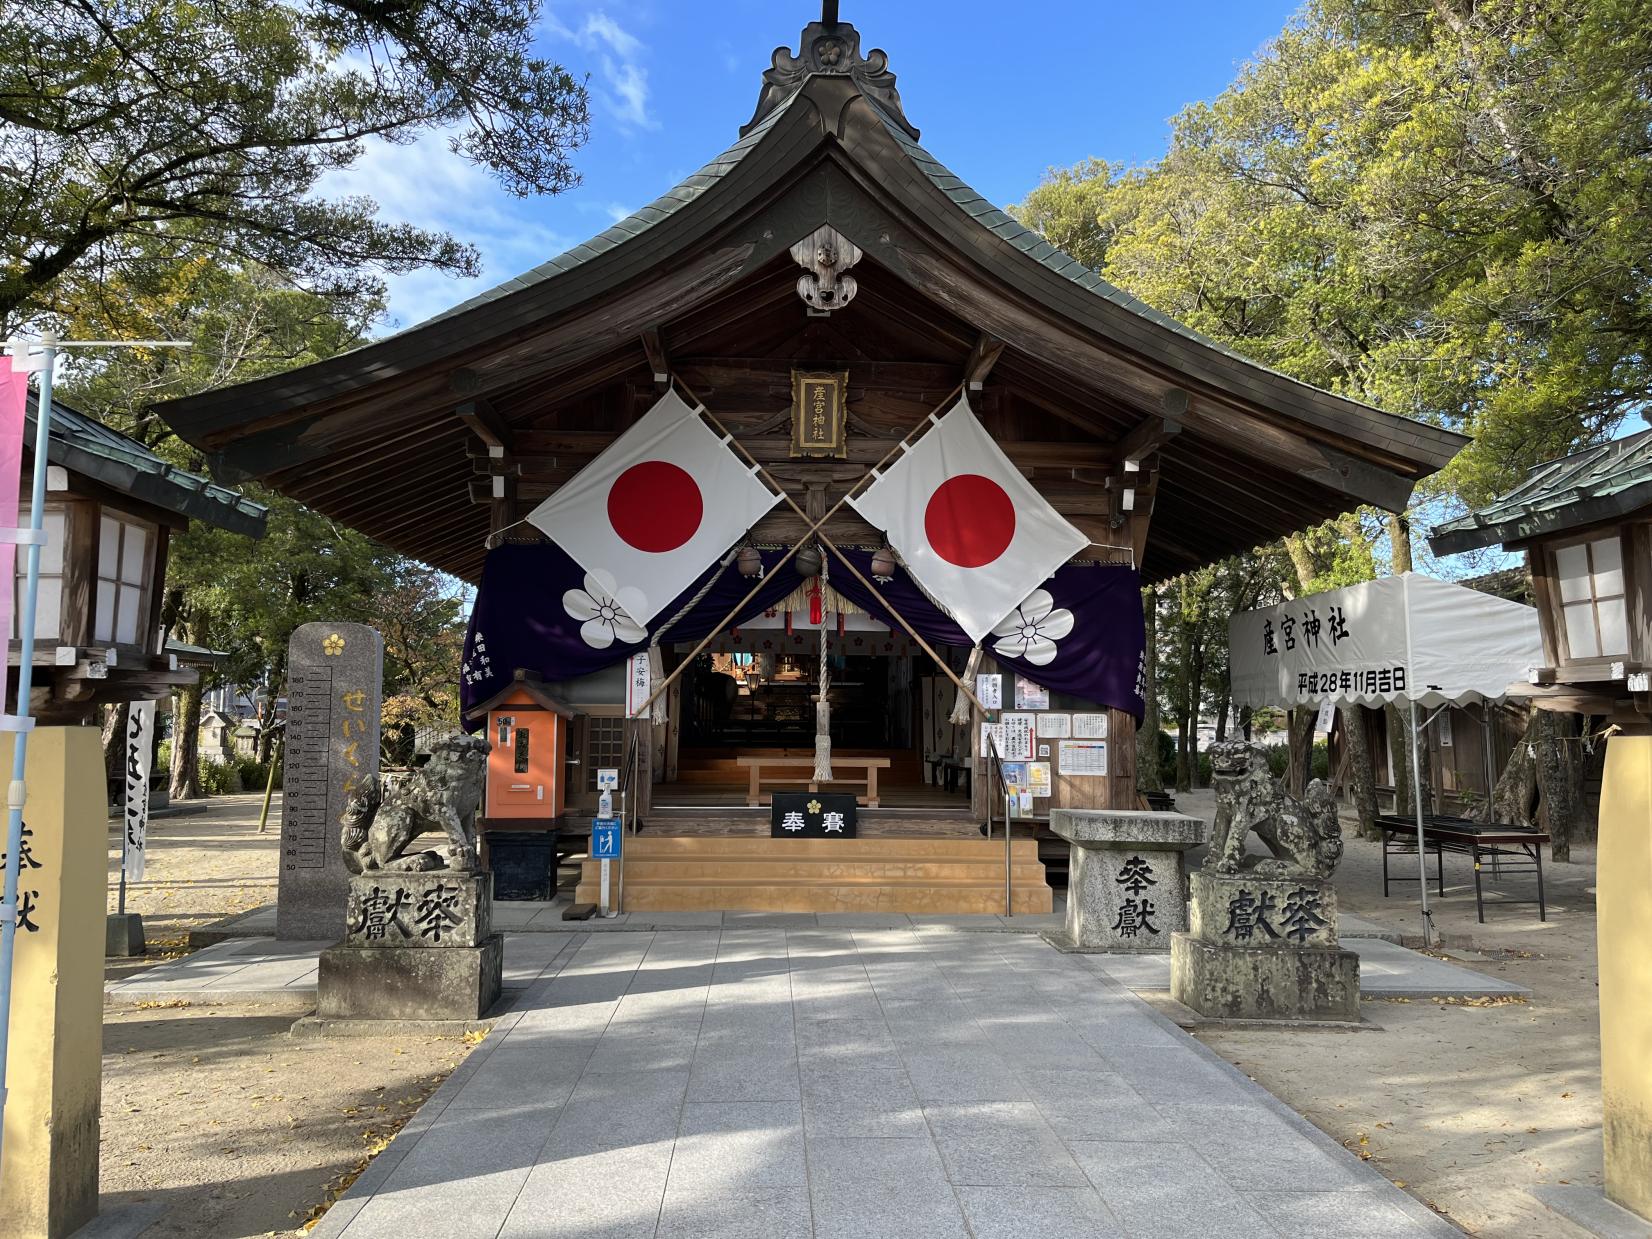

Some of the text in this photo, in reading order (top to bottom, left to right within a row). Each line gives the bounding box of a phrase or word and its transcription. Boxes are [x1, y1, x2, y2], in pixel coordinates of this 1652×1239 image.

[812, 386, 826, 440] 産宮神社
[1263, 606, 1350, 656] 産宮神社
[1298, 666, 1406, 695] 平成28年11月吉日
[340, 688, 367, 800] せいくら
[288, 762, 300, 770] 120
[288, 834, 298, 842] 70
